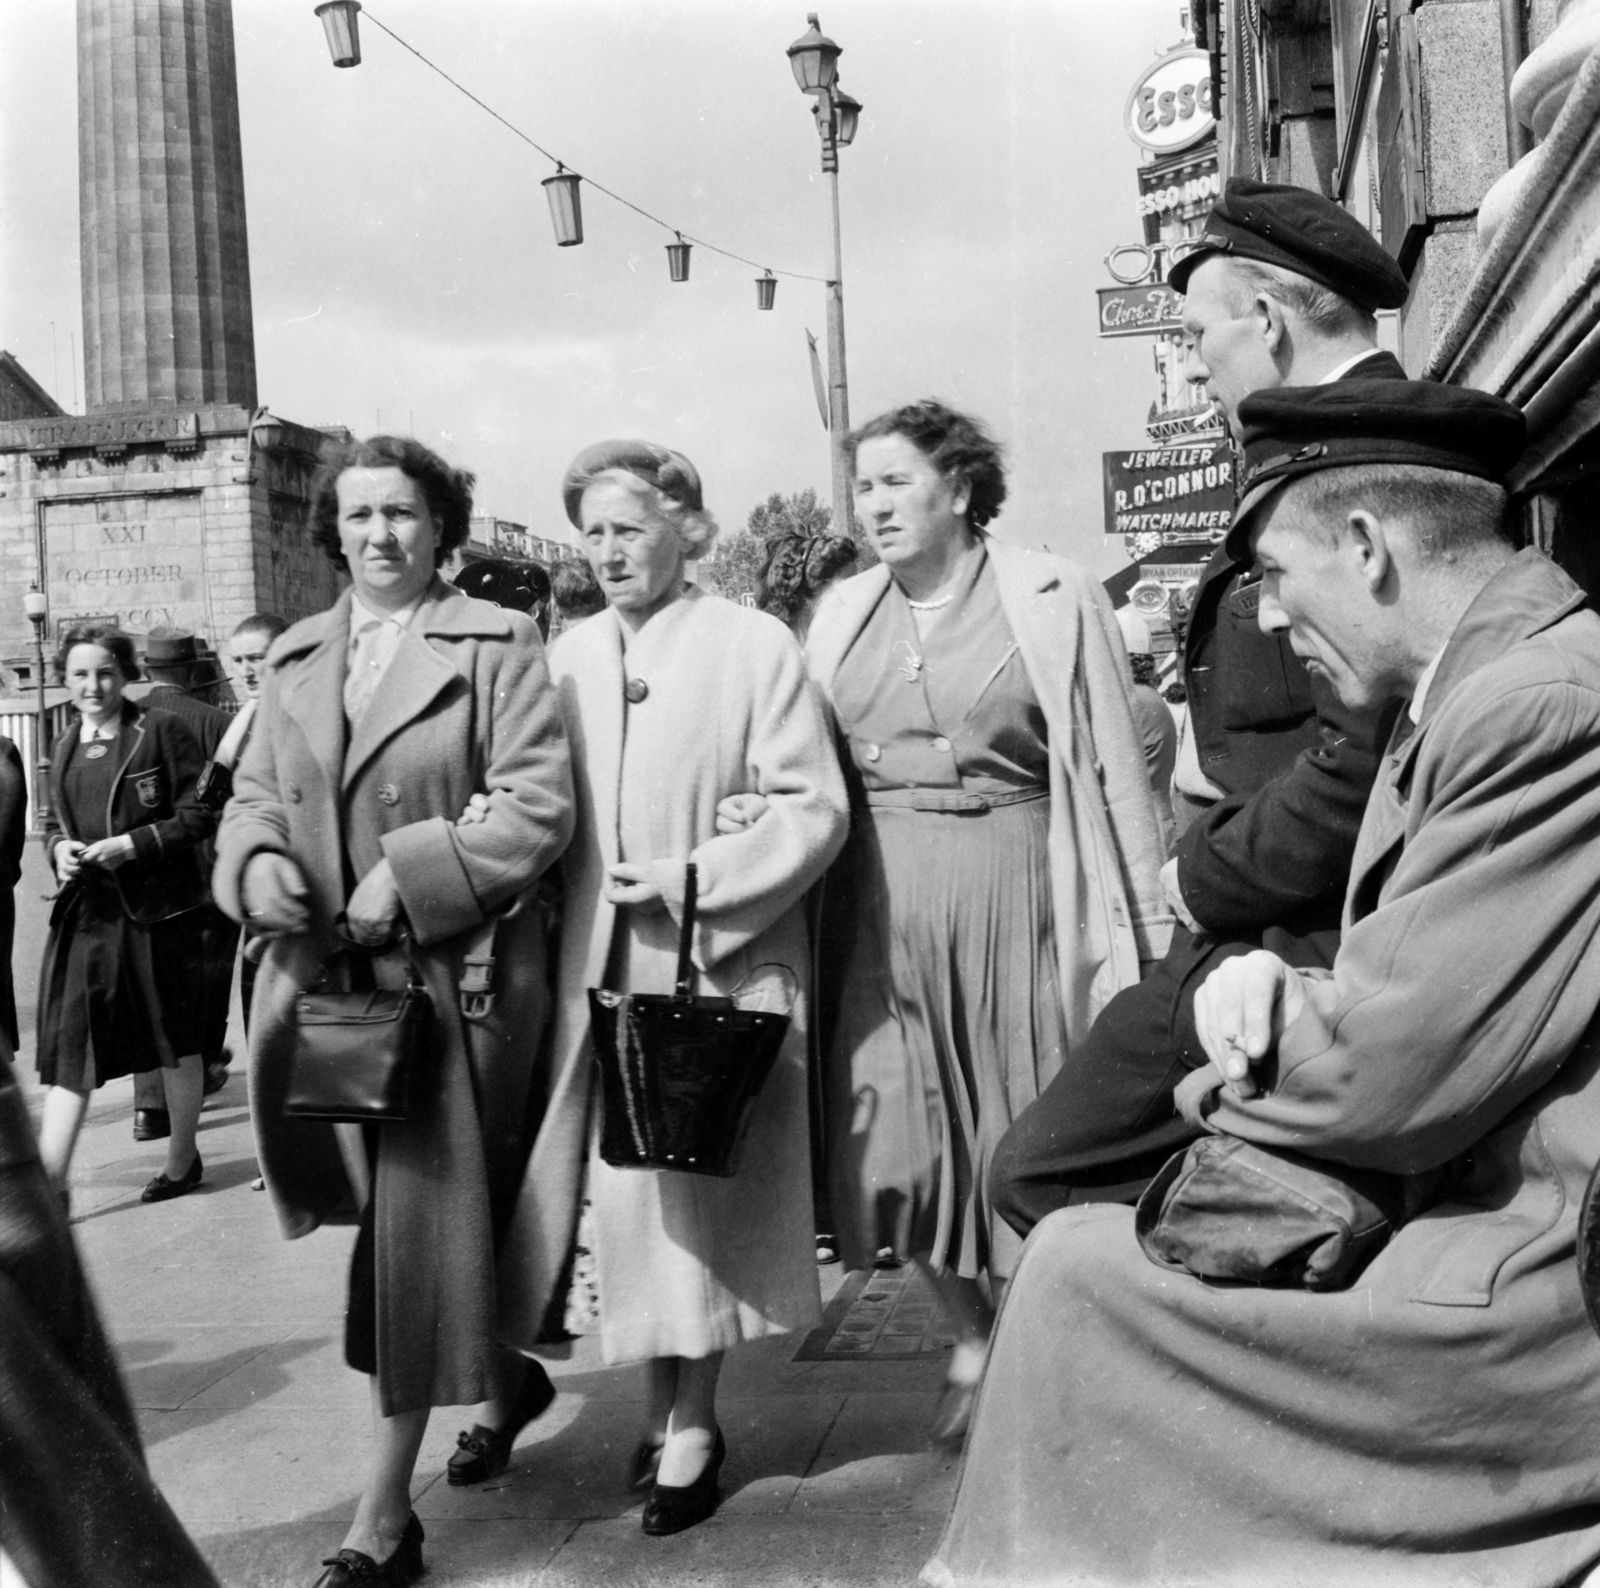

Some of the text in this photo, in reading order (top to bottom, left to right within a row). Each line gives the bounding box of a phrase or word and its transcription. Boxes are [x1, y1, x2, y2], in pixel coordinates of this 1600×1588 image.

[1137, 185, 1179, 216] ESSO
[31, 417, 191, 444] TRAFALGAR
[1122, 449, 1213, 468] JEWELLER
[1116, 510, 1231, 531] WATCHMAKER
[101, 525, 146, 545] XXI
[65, 564, 184, 587] OCTOBER
[1144, 566, 1165, 578] RYAN
[73, 607, 177, 627] CCCV
